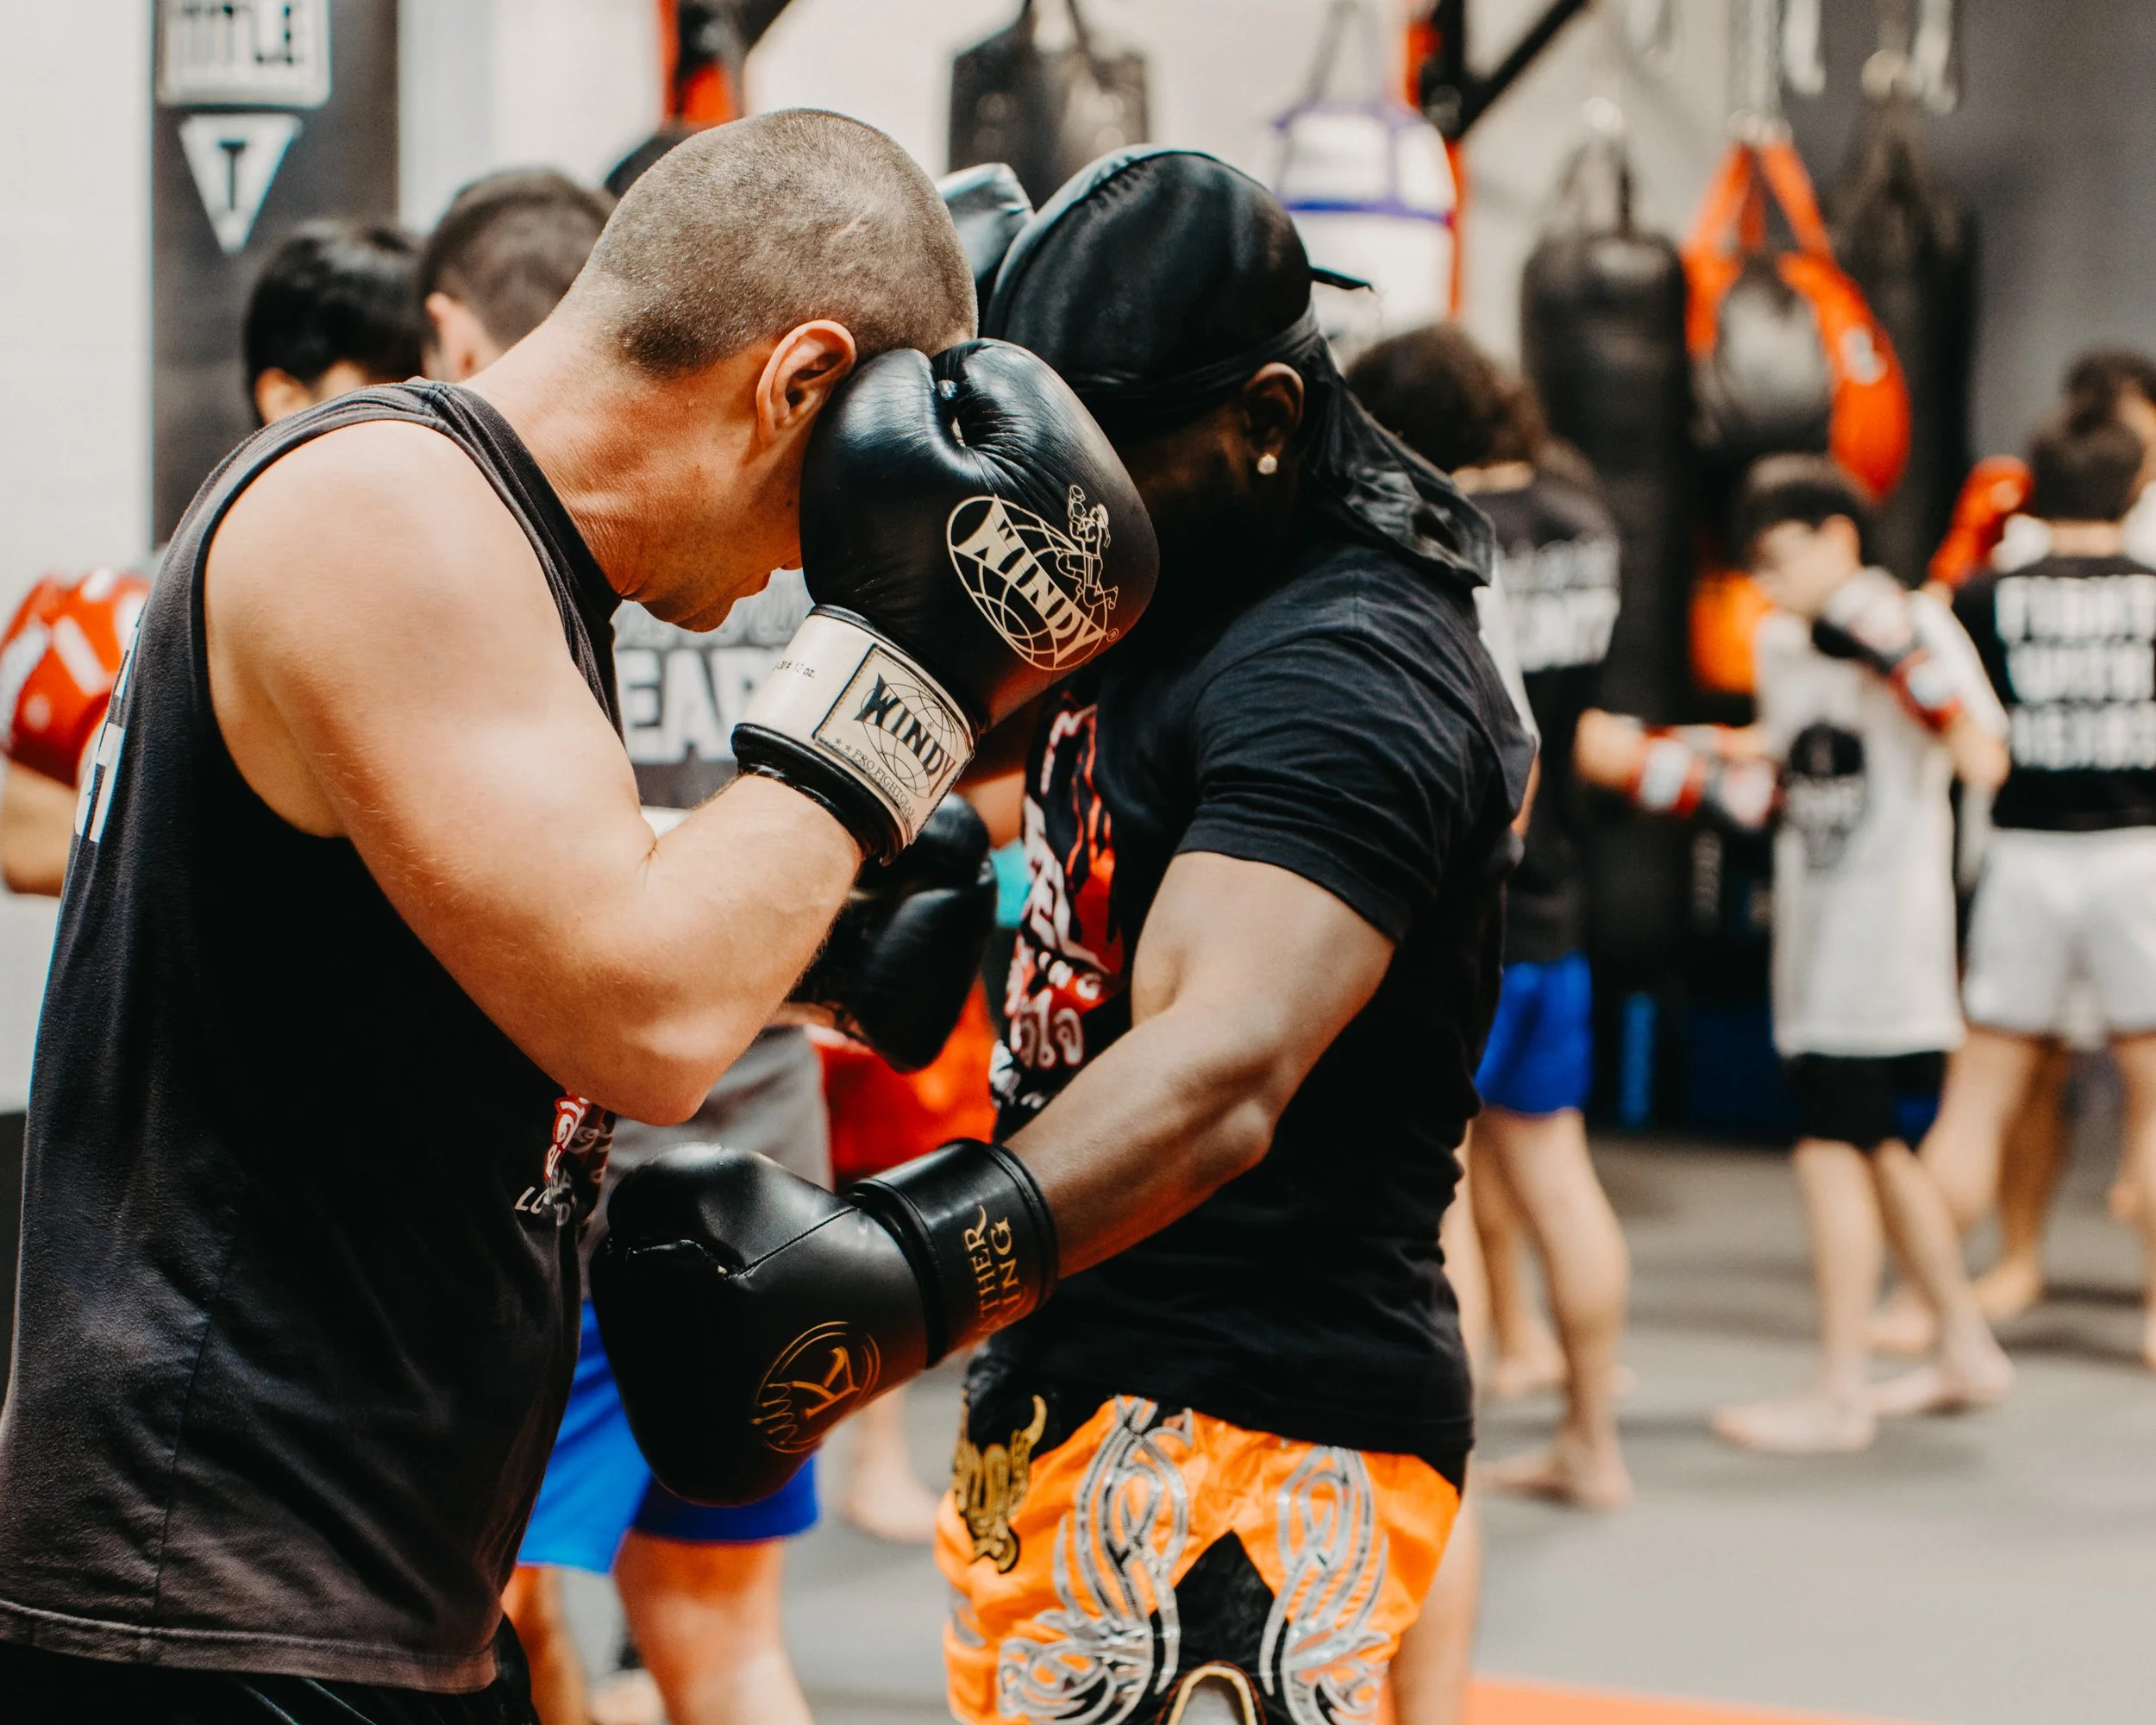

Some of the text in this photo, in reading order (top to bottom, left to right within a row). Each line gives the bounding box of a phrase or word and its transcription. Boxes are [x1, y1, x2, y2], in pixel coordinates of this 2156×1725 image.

[214, 138, 251, 213] T
[951, 492, 1108, 667] WINDY
[850, 748, 875, 770] PRO
[853, 673, 956, 797] WINDY
